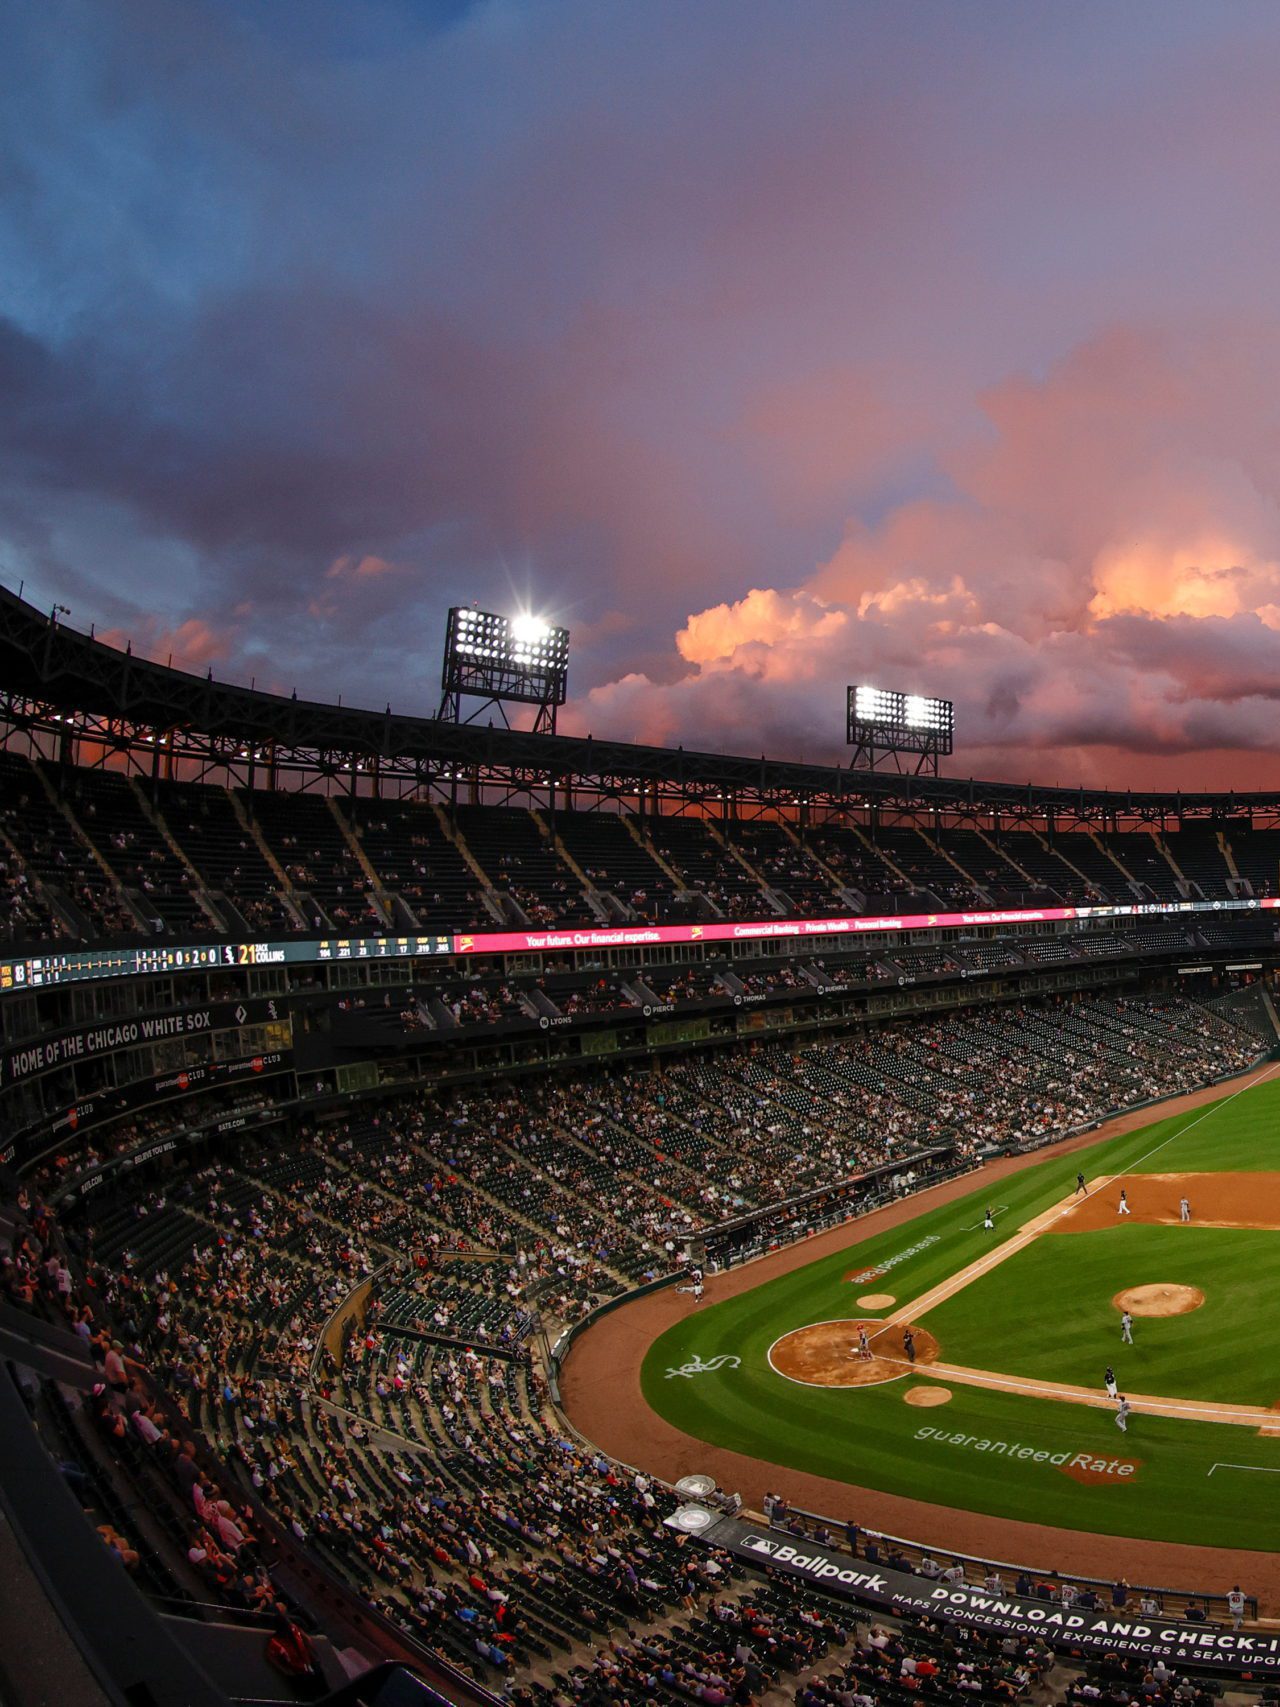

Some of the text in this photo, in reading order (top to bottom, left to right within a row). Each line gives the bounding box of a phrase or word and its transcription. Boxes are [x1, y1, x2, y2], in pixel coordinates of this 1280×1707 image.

[734, 924, 799, 937] Commercial Banking
[805, 921, 849, 933] Private Wealth
[854, 919, 902, 931] Personal Banking
[337, 939, 350, 948] AVG
[437, 936, 447, 944] SLG
[526, 931, 660, 947] Your future. Our financial expertise.
[239, 944, 255, 964] 21
[255, 943, 268, 953] ZACK
[358, 947, 367, 956] 23
[176, 950, 183, 966] 0
[192, 950, 199, 964] 2
[209, 949, 216, 964] 0
[256, 949, 285, 963] COLLINS
[15, 964, 25, 982] 83
[743, 993, 767, 1003] THOMAS
[653, 1004, 676, 1014] PIERCE
[550, 1016, 573, 1026] LYONS
[11, 1011, 211, 1078] HOME OF THE CHICAGO WHITE SOX
[218, 1117, 246, 1131] RATE.COM
[152, 1144, 163, 1157] YOU
[850, 1235, 941, 1284] guaranteed Rate
[913, 1426, 1135, 1476] guaranteed Rate
[930, 1587, 1085, 1628] DOWNLOAD
[1090, 1620, 1152, 1639] AND
[892, 1593, 932, 1609] MAPS
[943, 1605, 1049, 1636] CONCESSIONS
[1062, 1631, 1172, 1656] EXPERIENCES
[1176, 1648, 1187, 1657] &
[1192, 1650, 1236, 1663] SEAT
[959, 1632, 969, 1640] 79
